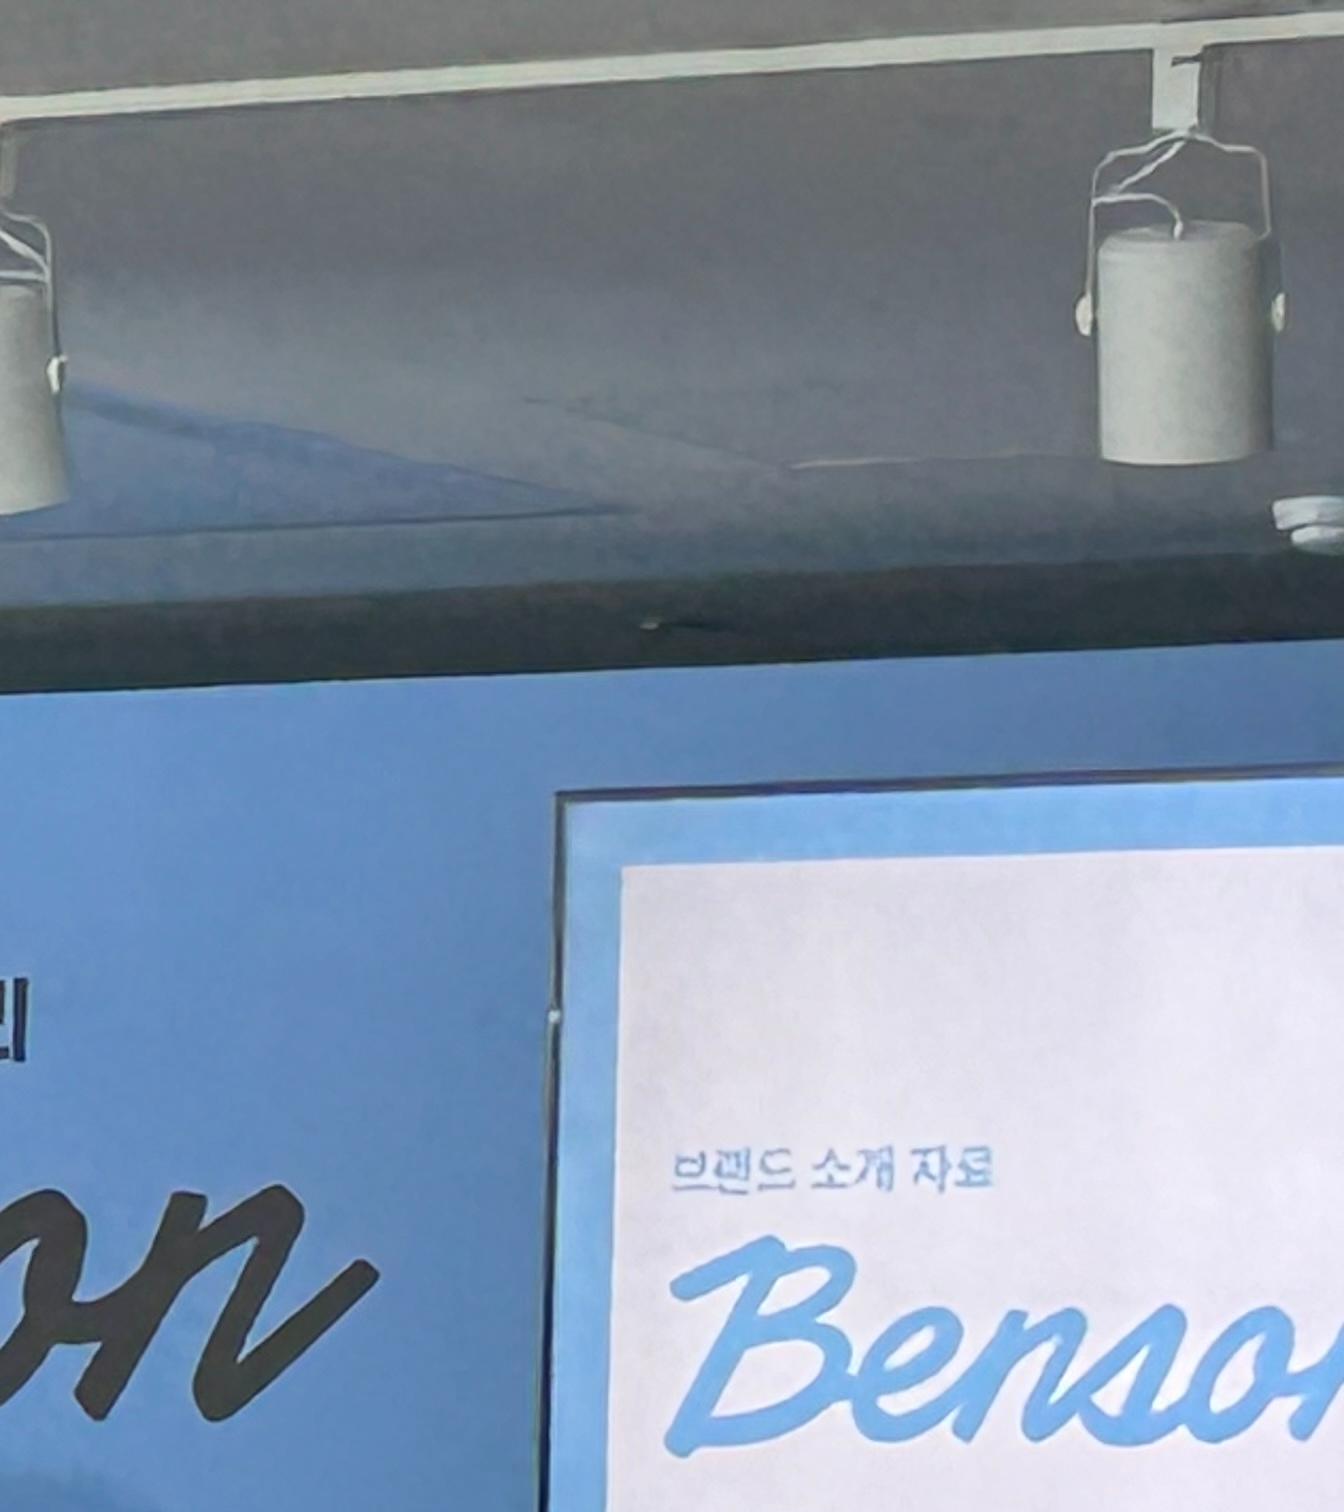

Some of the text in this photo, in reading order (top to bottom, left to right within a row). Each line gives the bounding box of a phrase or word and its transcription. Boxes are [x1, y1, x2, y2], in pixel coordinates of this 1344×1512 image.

[671, 1144, 993, 1196] 브랜드 소개 자료
[663, 1234, 1344, 1459] Benso
